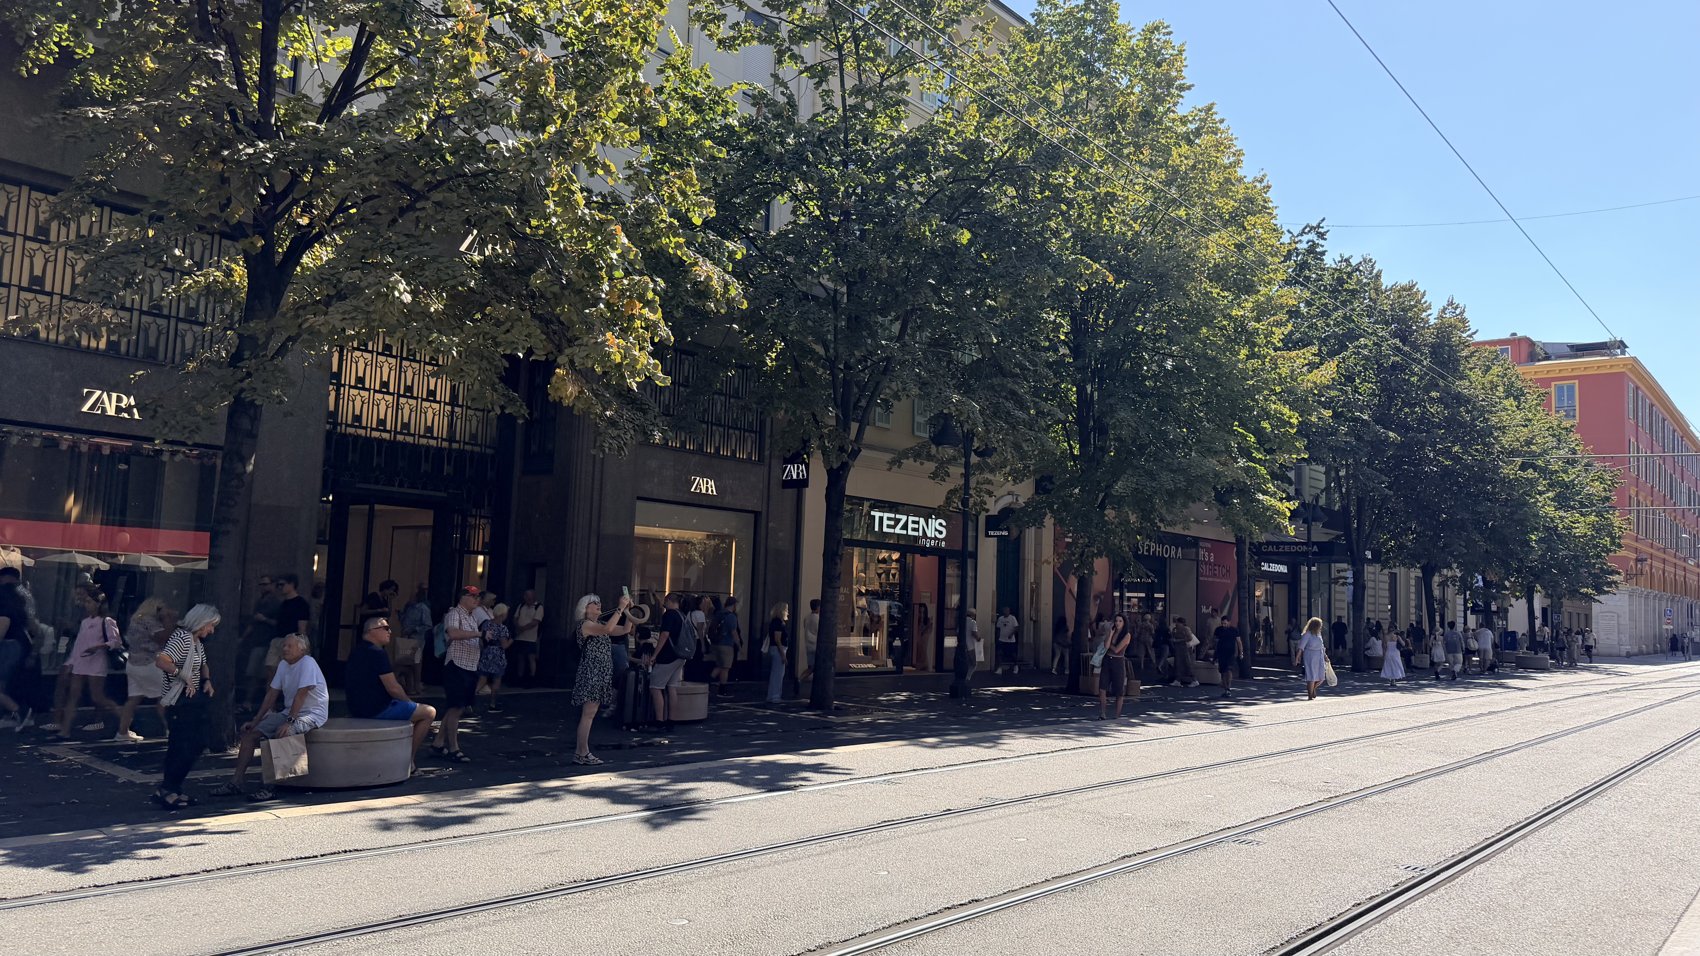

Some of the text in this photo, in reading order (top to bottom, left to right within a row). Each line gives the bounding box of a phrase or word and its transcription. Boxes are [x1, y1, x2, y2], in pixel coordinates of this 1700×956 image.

[81, 388, 143, 420] ZARA
[782, 463, 807, 480] ZARA
[690, 476, 718, 496] ZARA
[870, 509, 947, 539] TEZENIS
[1137, 541, 1183, 559] SEPHORA
[1199, 562, 1231, 578] STRETCH
[1260, 561, 1288, 573] CALZEDONIA
